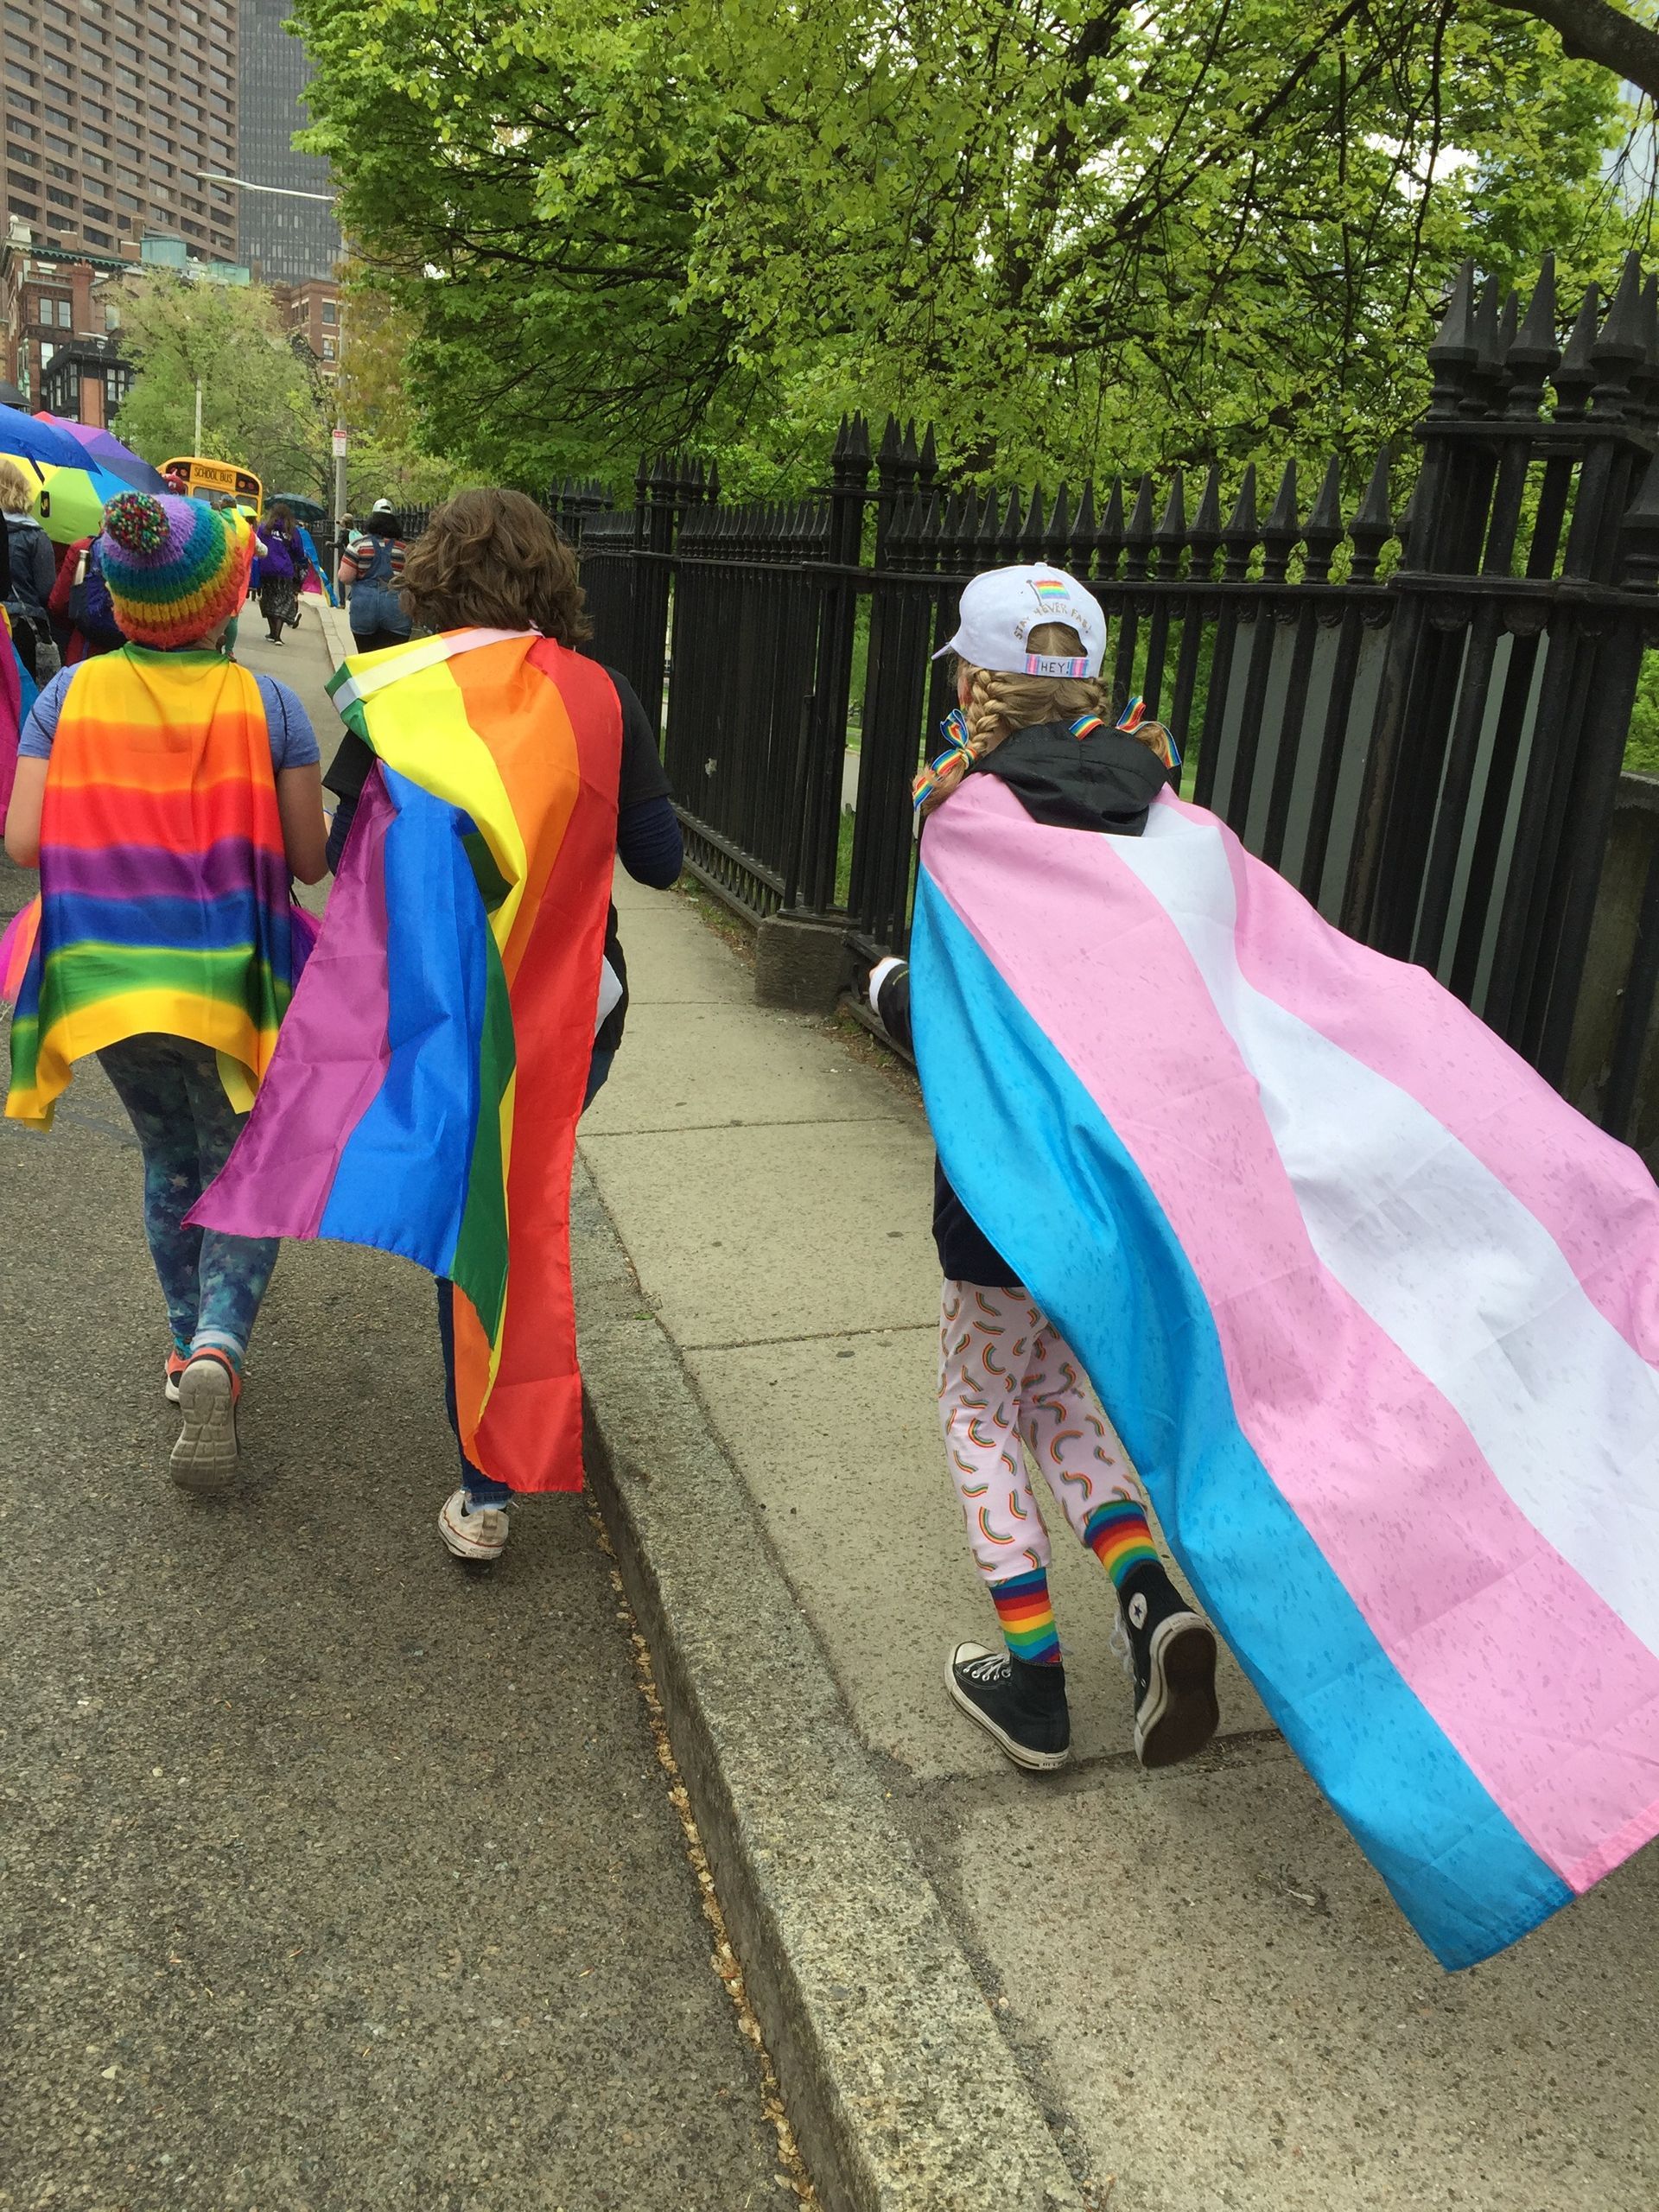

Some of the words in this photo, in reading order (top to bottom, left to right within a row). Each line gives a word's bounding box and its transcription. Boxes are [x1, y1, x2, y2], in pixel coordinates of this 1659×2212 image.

[194, 467, 219, 480] SCHOOL
[219, 473, 233, 484] BUS
[1014, 616, 1030, 640] STAY
[1040, 661, 1070, 674] HEY!
